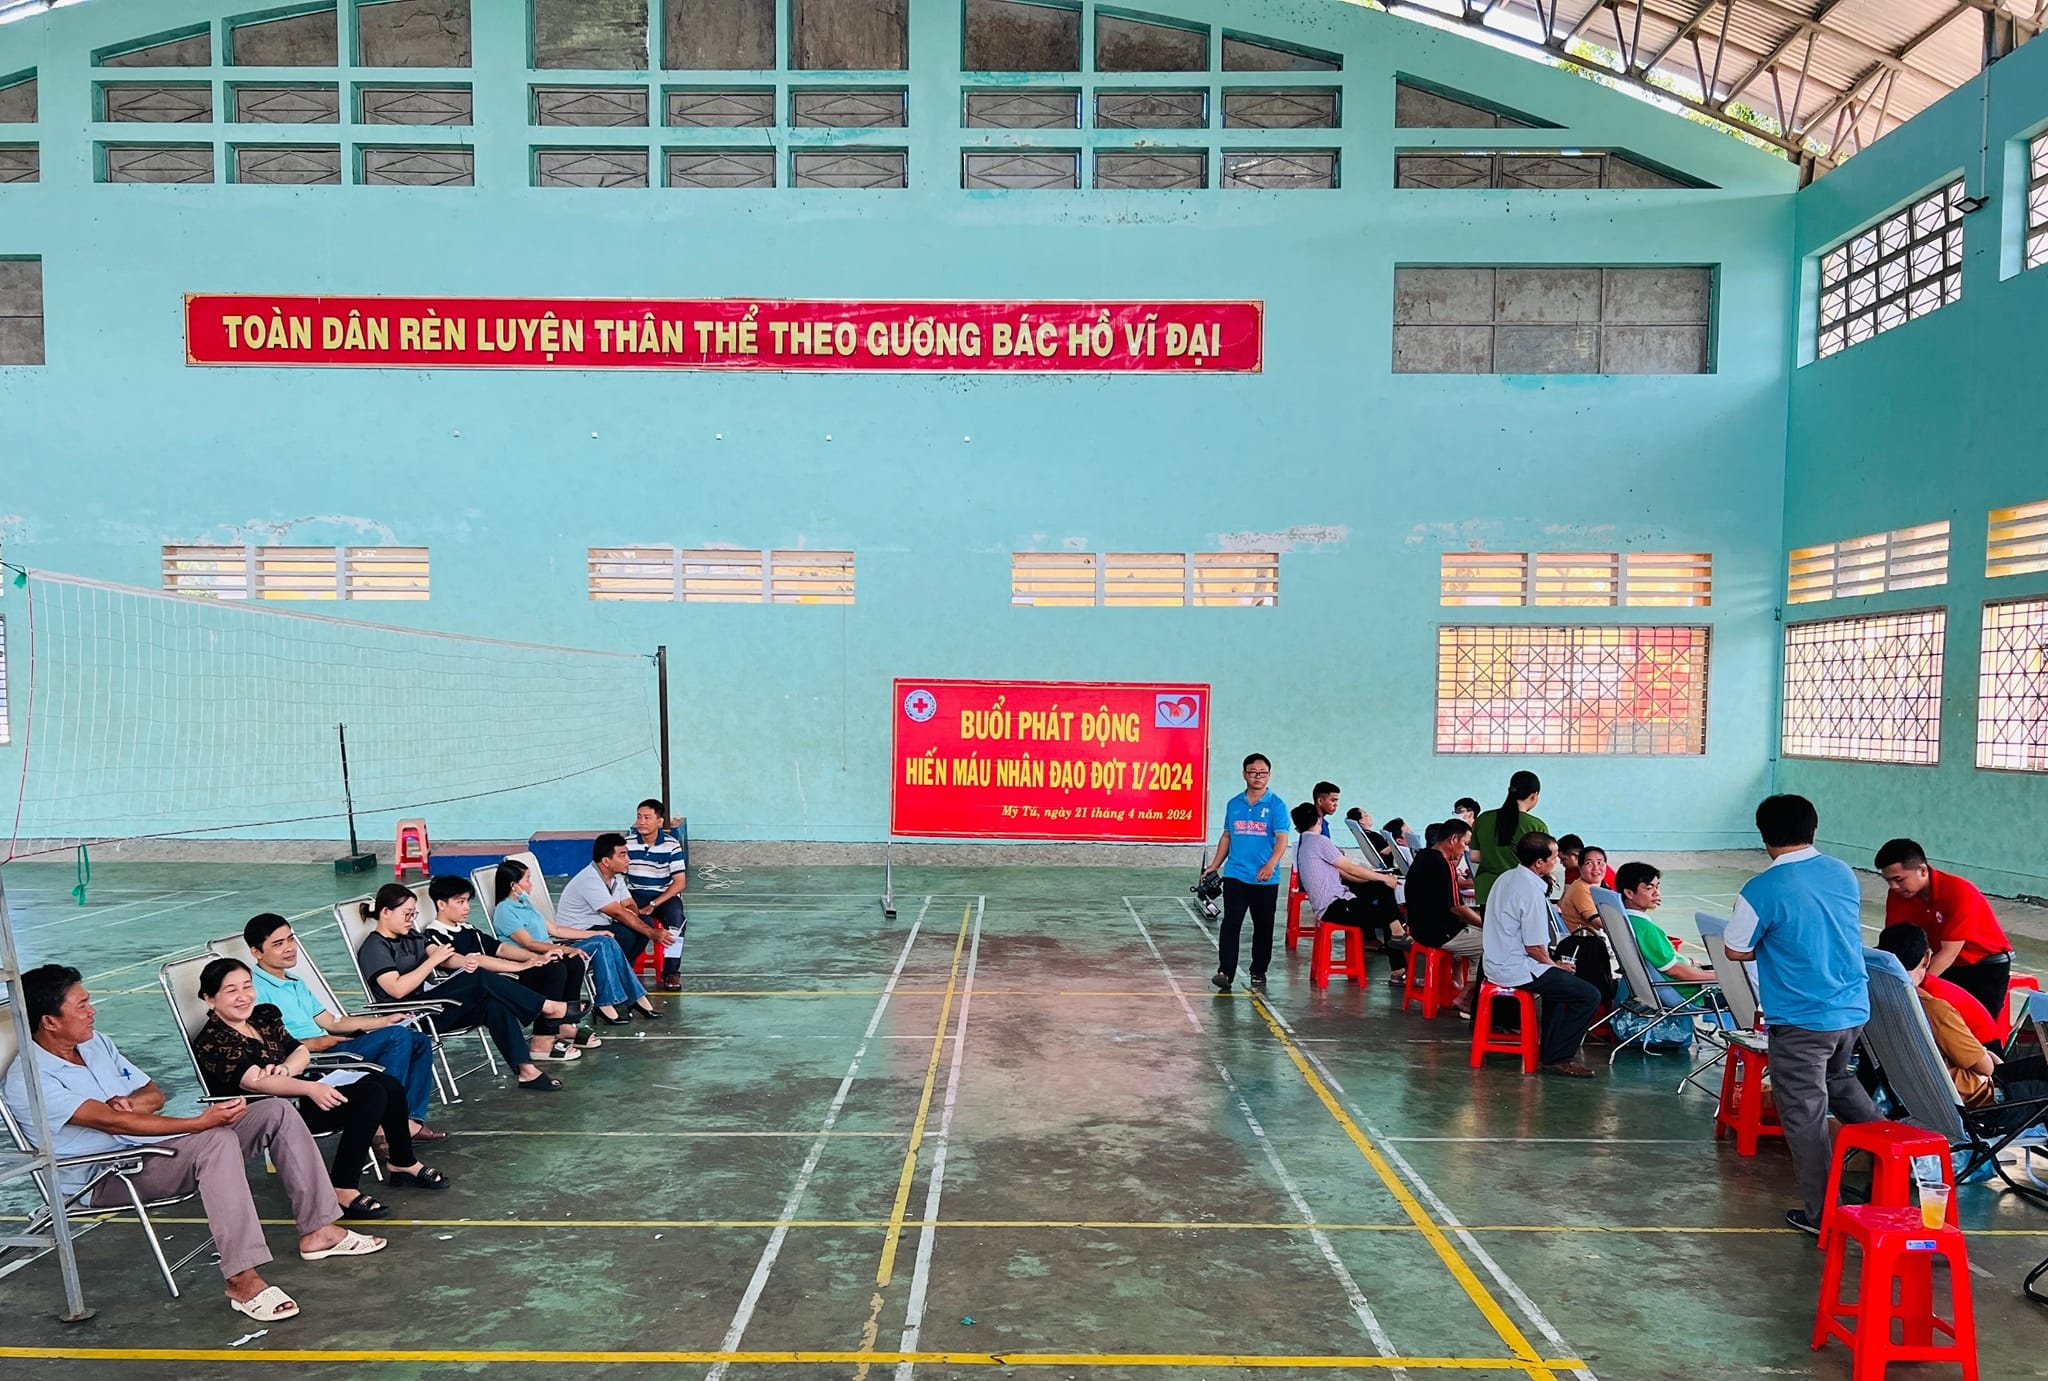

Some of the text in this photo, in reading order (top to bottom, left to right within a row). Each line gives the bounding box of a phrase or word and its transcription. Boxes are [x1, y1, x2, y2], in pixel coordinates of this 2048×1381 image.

[222, 303, 1221, 366] TOÀN DÂN RÈN LUYỆN THÂN THỂ THEO GƯƠNG BÁC HỒ VĨ ĐẠI
[960, 695, 1011, 740] BUỔI
[1018, 703, 1074, 741] PHÁT
[1080, 704, 1140, 747] ĐỘNG
[905, 746, 1193, 796] HIẾN MÁU NHÂN ĐẠO ĐỢT I/2024
[1044, 807, 1072, 820] ngày
[1074, 806, 1087, 818] 21
[1090, 806, 1125, 821] tháng
[1127, 808, 1135, 819] 4
[1137, 809, 1163, 820] năm
[1166, 809, 1192, 820] 2024
